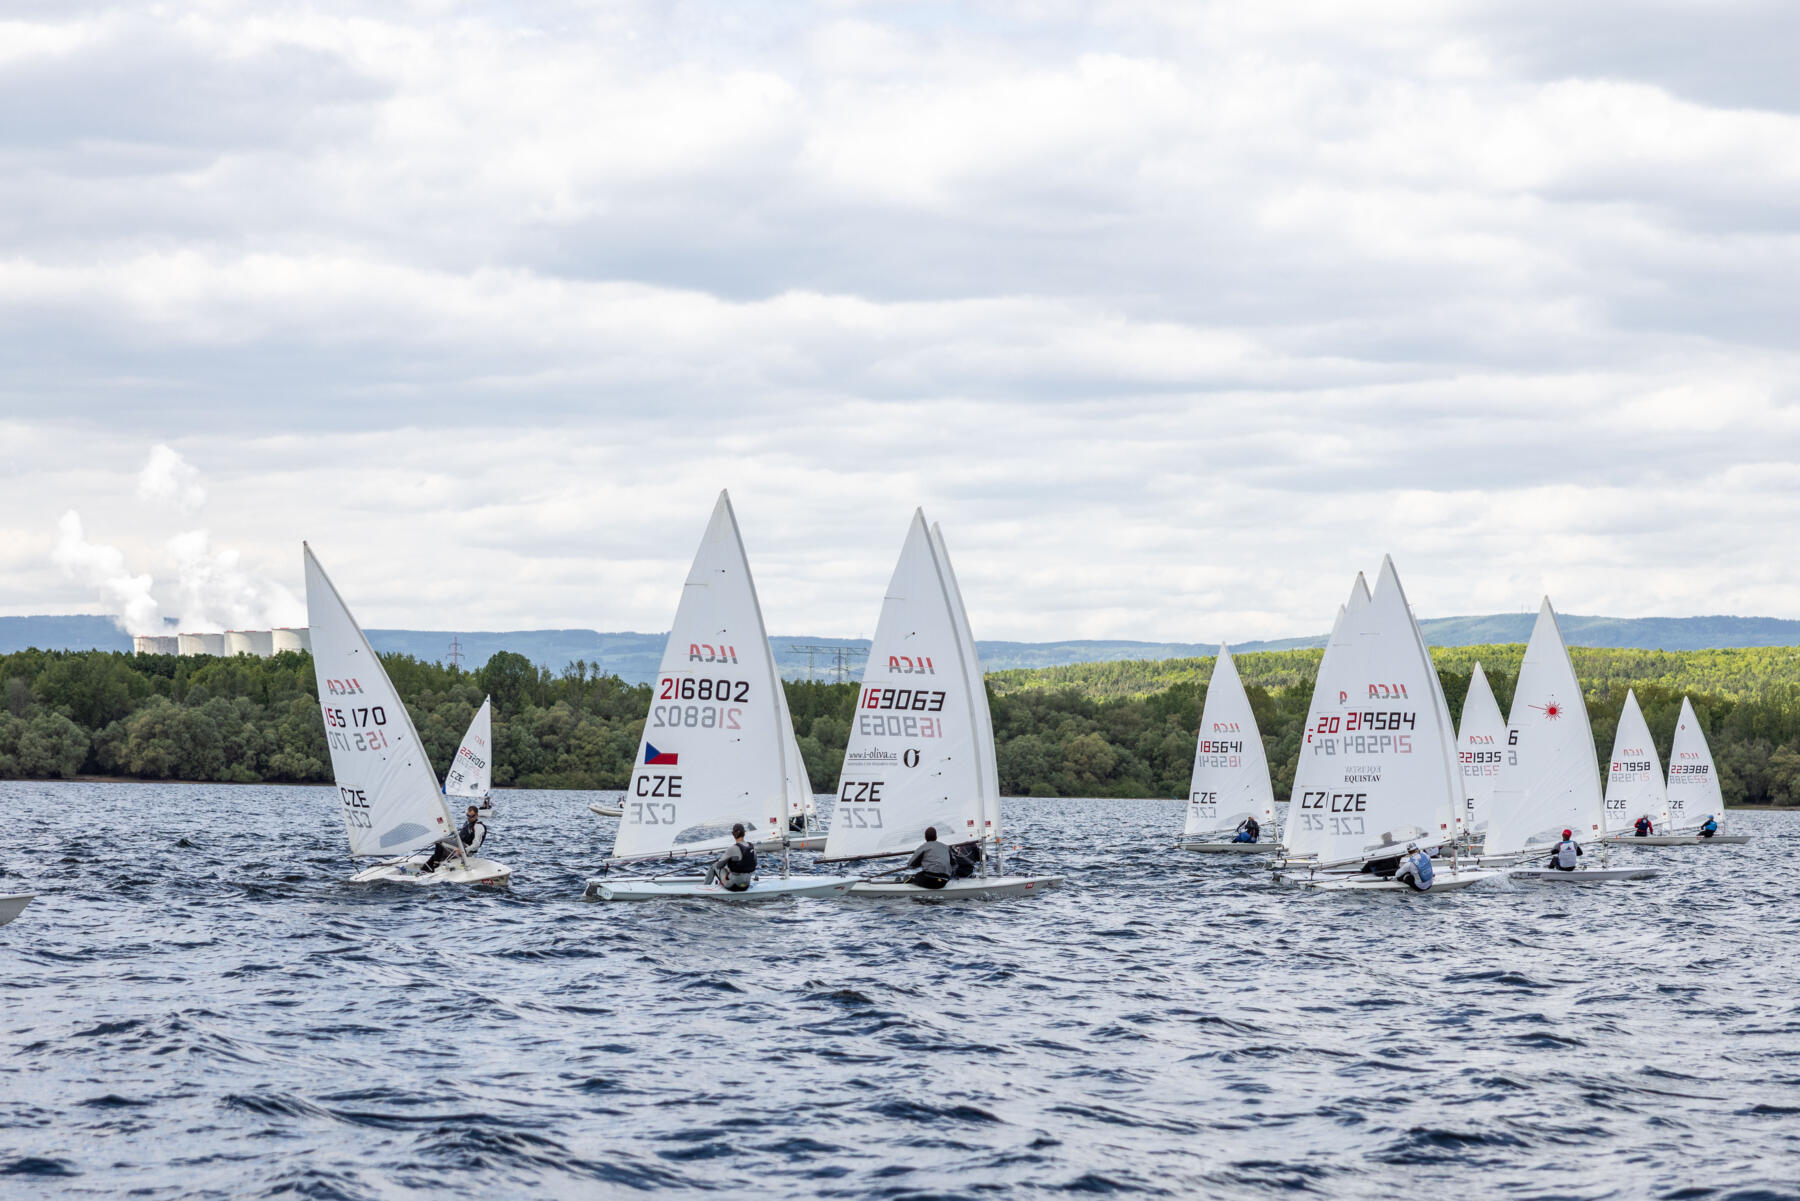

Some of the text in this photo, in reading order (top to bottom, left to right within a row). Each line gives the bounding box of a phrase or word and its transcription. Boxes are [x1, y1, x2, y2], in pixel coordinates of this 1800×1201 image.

[660, 678, 749, 703] 216802
[861, 688, 946, 711] 169063
[1346, 712, 1416, 730] 219584
[1508, 730, 1519, 745] 6
[849, 747, 897, 759] www.i-oliva.cz
[1200, 741, 1242, 753] 185641
[1458, 752, 1502, 763] 221935
[1612, 762, 1651, 771] 217958
[1671, 765, 1708, 774] 223388
[450, 770, 465, 783] CZE
[1344, 775, 1381, 783] EQUISTAV
[636, 775, 682, 797] CZE
[840, 782, 884, 802] CZE
[341, 787, 370, 808] CZE
[1192, 792, 1217, 804] CZE
[1331, 794, 1367, 812] CZE
[1606, 800, 1626, 809] CZE
